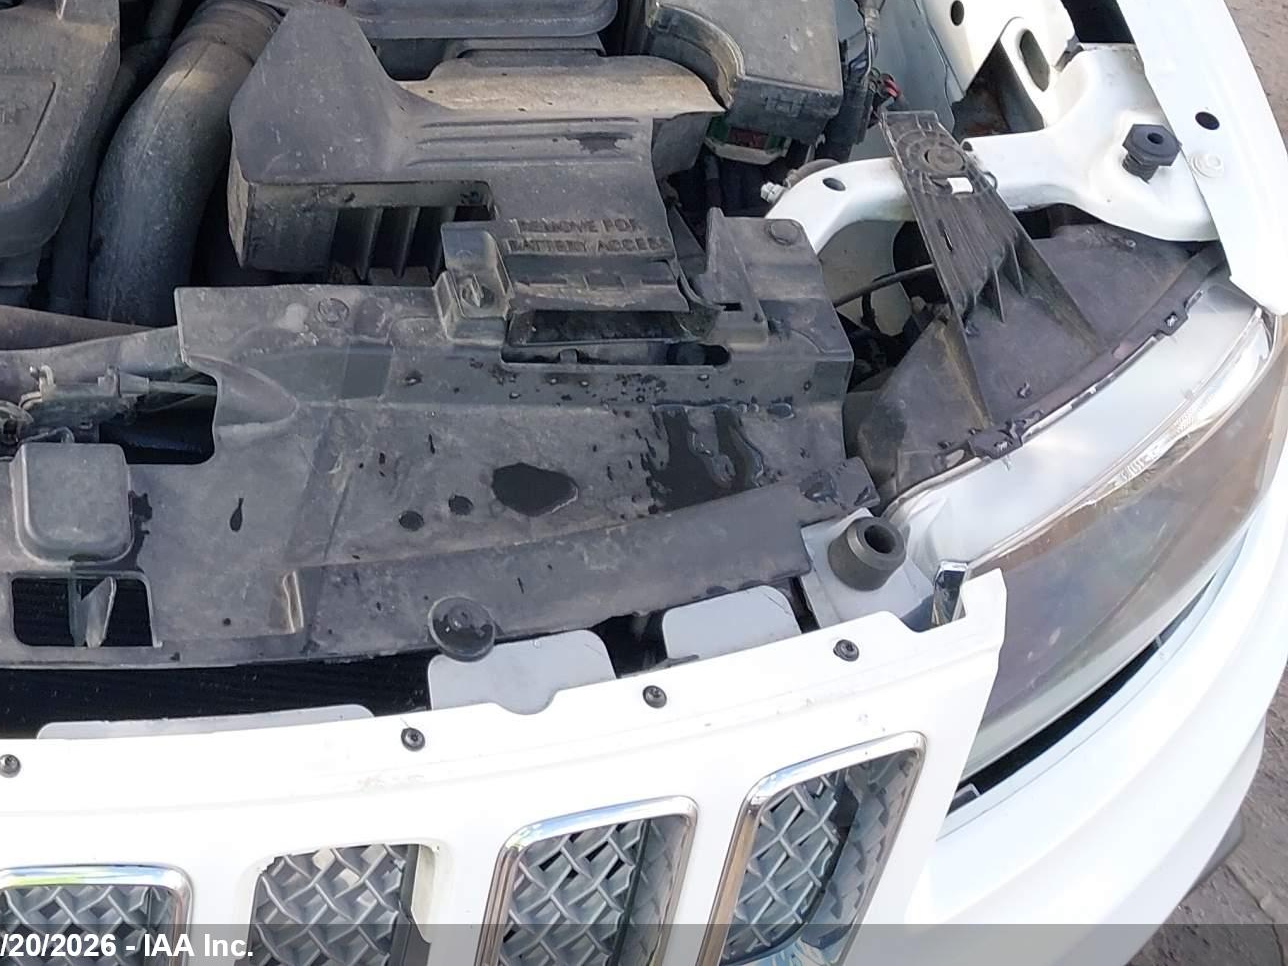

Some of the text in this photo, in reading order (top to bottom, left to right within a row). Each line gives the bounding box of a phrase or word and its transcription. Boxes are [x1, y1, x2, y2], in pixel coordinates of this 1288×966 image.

[514, 217, 644, 234] REMOVE FOR
[506, 236, 672, 254] BATTERY ACCESS
